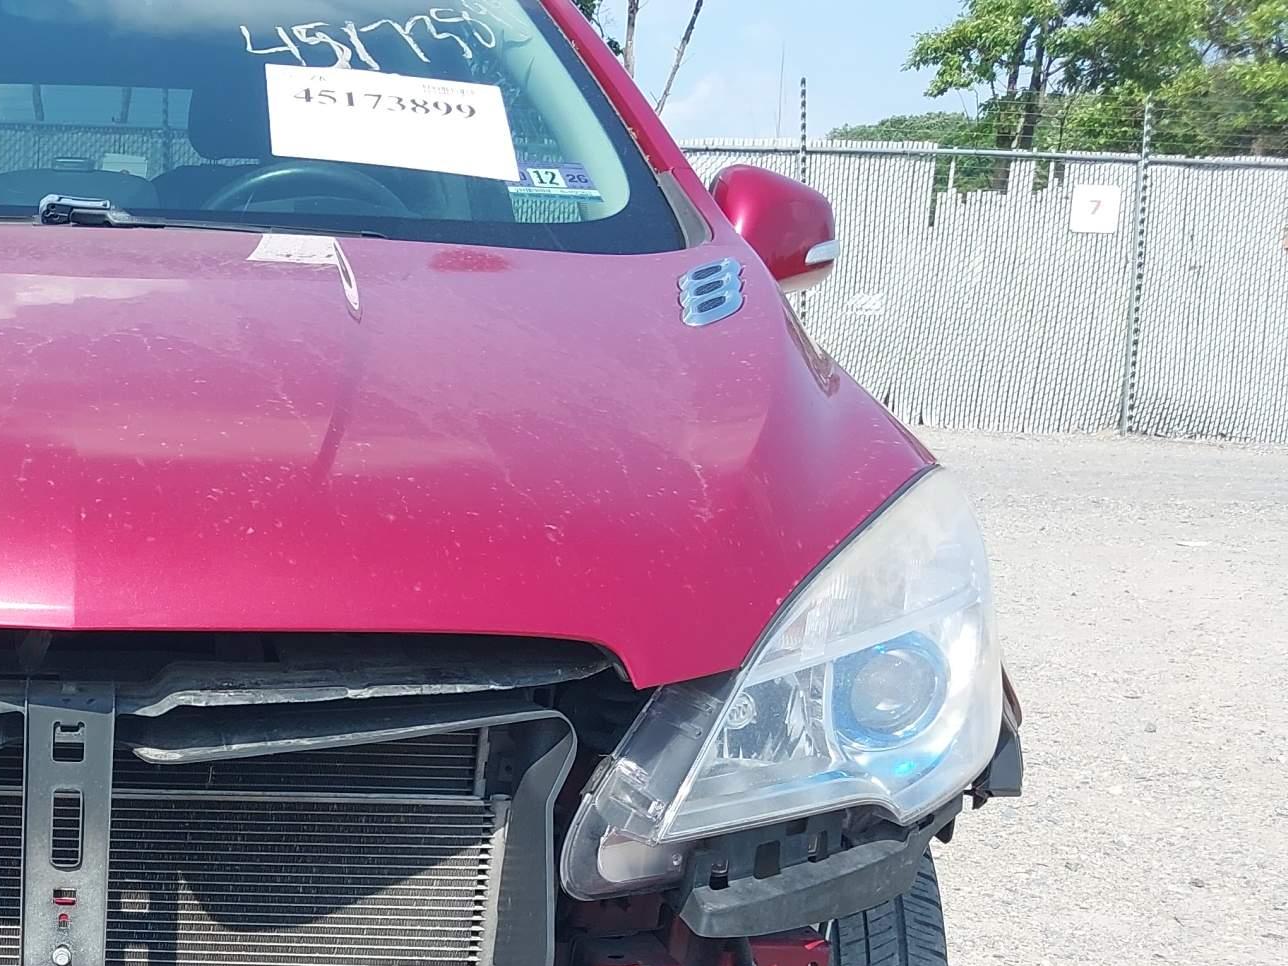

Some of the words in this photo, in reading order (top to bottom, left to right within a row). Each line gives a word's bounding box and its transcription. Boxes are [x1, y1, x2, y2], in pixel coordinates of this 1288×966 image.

[294, 88, 476, 118] 45173899
[533, 170, 560, 186] 12
[1088, 199, 1102, 215] 7
